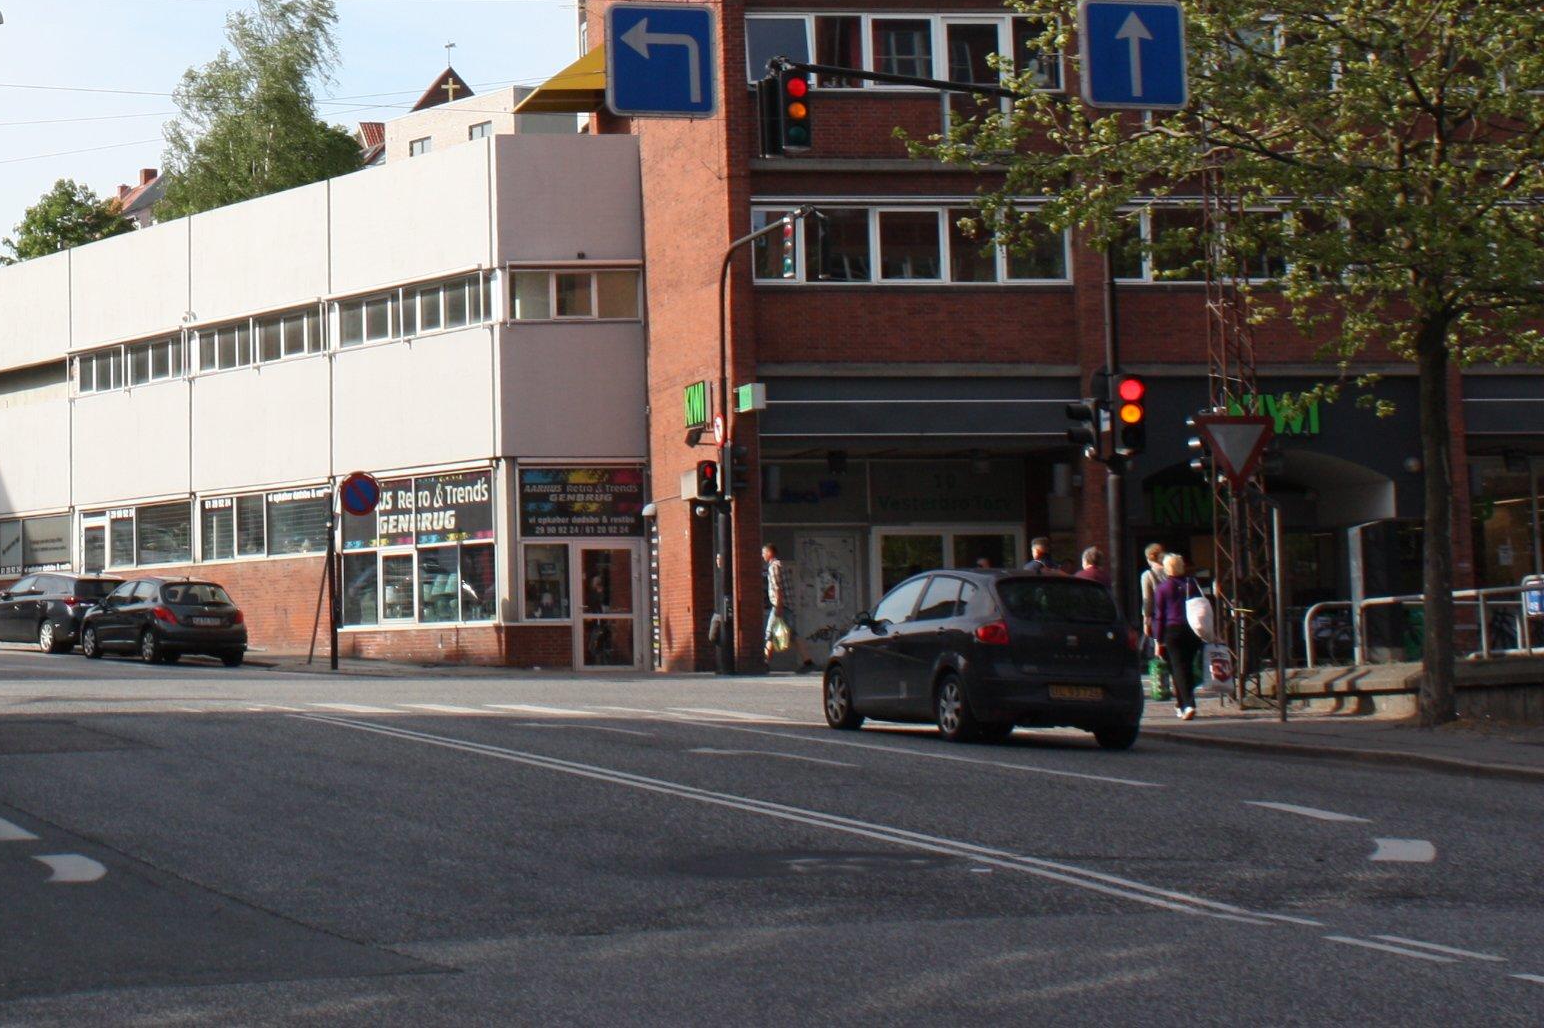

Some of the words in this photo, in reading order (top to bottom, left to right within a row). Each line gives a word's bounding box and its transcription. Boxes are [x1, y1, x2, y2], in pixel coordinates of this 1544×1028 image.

[684, 382, 705, 428] KIWI
[523, 484, 563, 493] AARHUS
[566, 484, 593, 493] Retro
[548, 493, 614, 502] GENBRUG
[379, 509, 456, 534] GENBRUG
